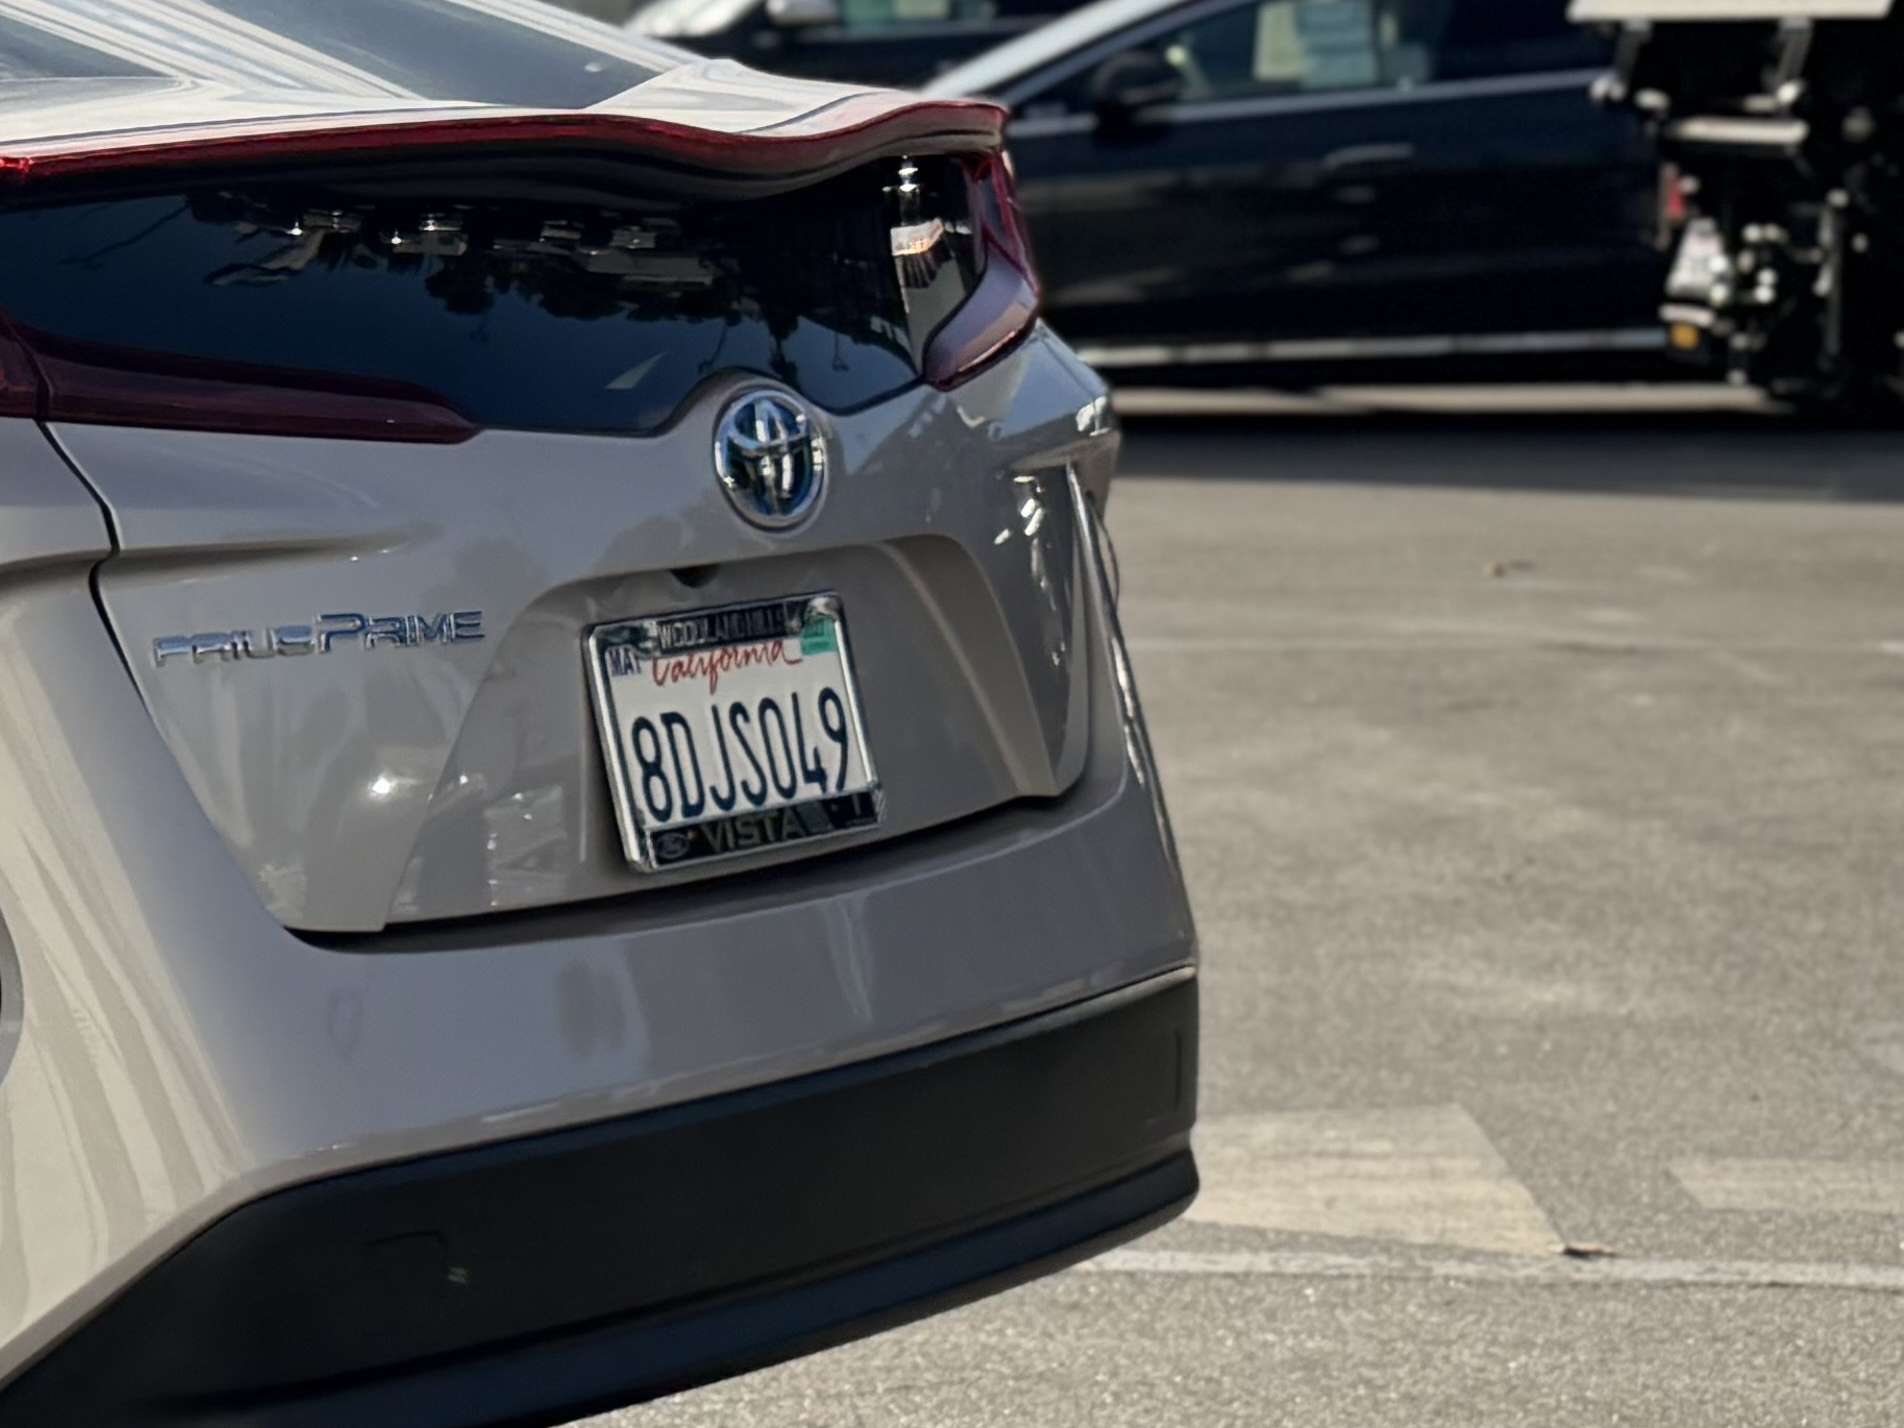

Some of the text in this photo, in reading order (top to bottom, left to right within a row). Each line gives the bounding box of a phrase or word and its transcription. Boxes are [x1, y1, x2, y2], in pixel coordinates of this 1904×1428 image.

[652, 639, 802, 695] California
[631, 686, 849, 823] 8DJS049
[702, 808, 804, 853] VISTA
